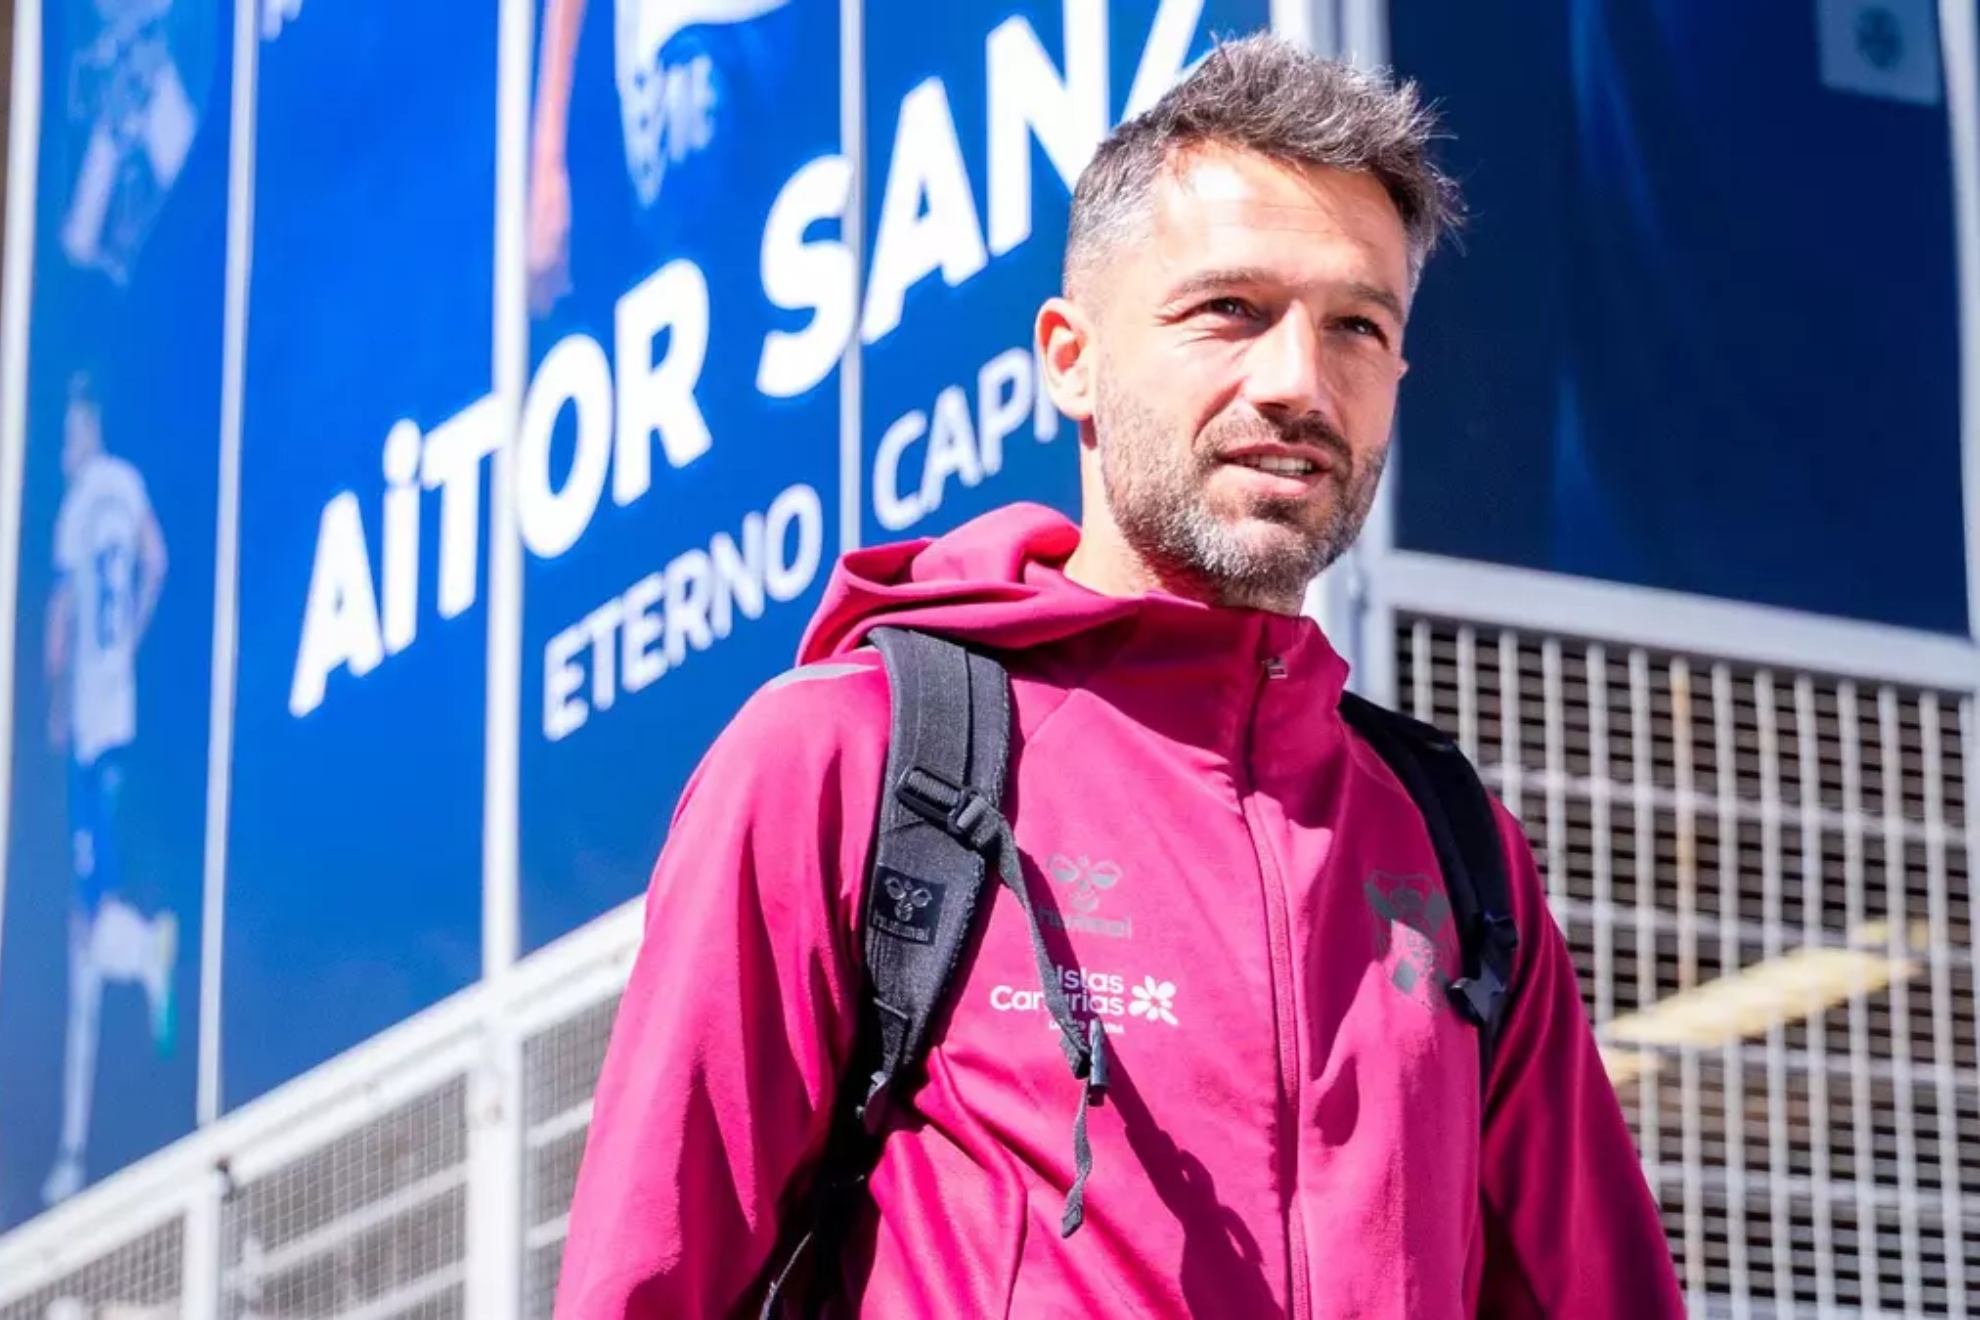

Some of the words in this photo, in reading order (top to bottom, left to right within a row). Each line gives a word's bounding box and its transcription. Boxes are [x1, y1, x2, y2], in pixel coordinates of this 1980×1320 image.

[543, 483, 823, 742] ETERNO
[1057, 964, 1125, 993] Islas
[989, 984, 1125, 1017] Canrias
